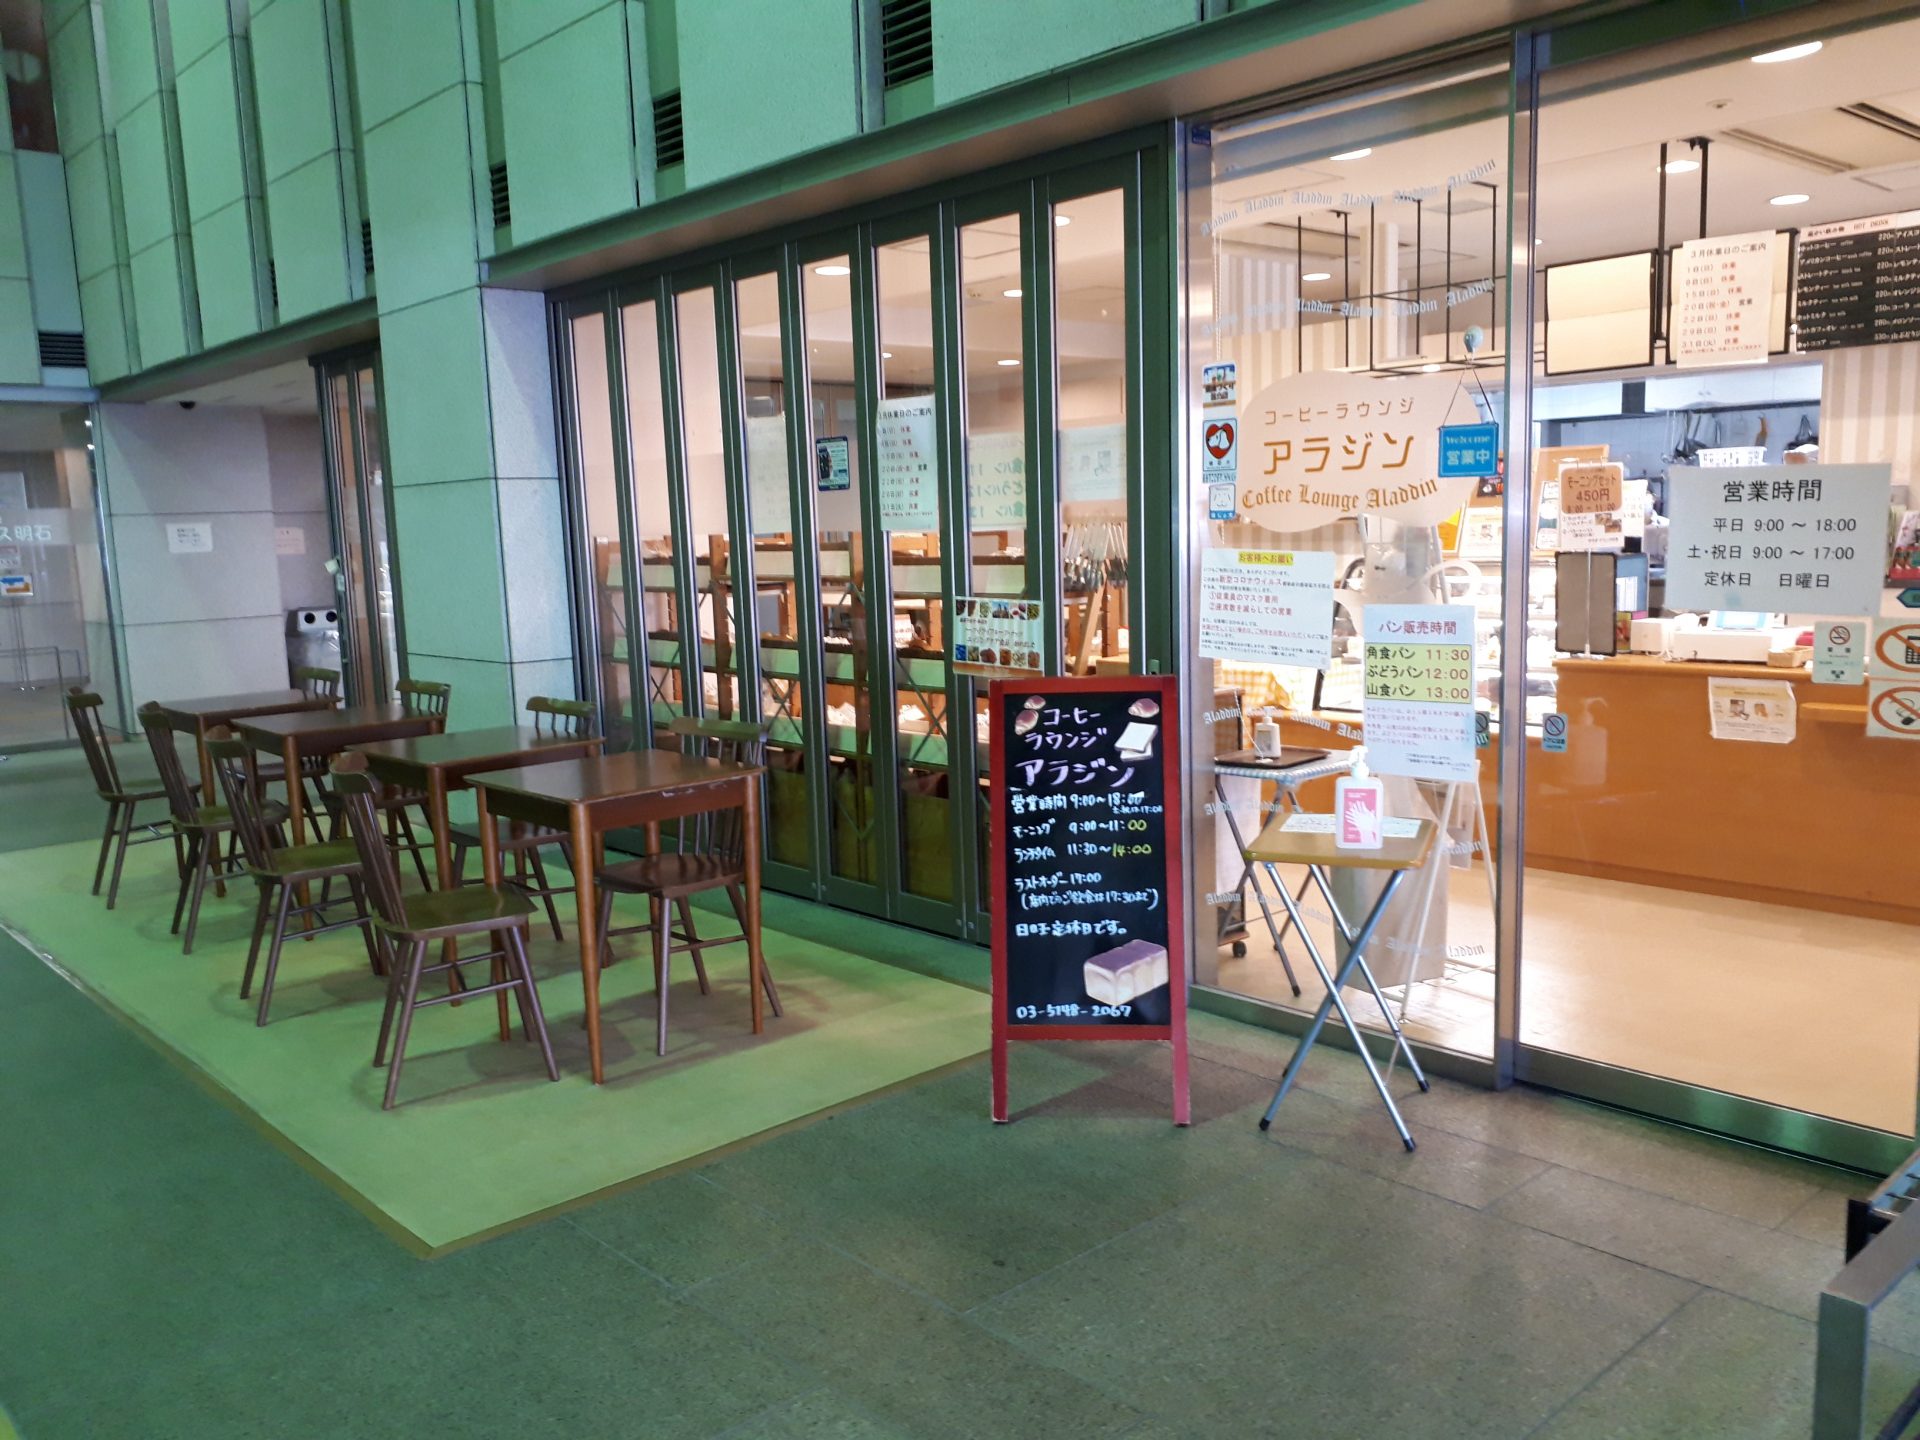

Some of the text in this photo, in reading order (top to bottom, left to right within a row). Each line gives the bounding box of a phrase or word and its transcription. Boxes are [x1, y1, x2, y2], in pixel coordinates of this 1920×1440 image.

[1245, 194, 1284, 213] Aladdin
[1292, 191, 1332, 205] Aladdin
[1448, 159, 1496, 188] Aladdin
[1447, 278, 1495, 307] Aladdin
[1265, 397, 1415, 425] コーヒーラウンジ
[1446, 435, 1490, 444] Welcome
[1263, 432, 1414, 475] アラジン
[1446, 449, 1490, 466] 営業中
[1567, 474, 1617, 489] モーニングセット
[1242, 478, 1437, 512] Coffee Lounge Aladdin
[1576, 488, 1610, 501] 450円
[1724, 480, 1822, 503] 営業時間
[1713, 518, 1744, 532] 平日
[1754, 518, 1784, 532] 9:00
[1816, 518, 1857, 532] 18:00
[1239, 552, 1293, 564] お客様へお願い
[1687, 544, 1742, 560] 土・祝日
[1753, 546, 1783, 559] 9:00
[1813, 546, 1855, 560] 17:00
[1704, 571, 1830, 589] 定休日 日曜日
[1379, 620, 1457, 635] パン販売時間
[1367, 646, 1469, 661] 角食パン 11:30
[1367, 665, 1468, 680] ぶどうパン 12:00
[1367, 683, 1469, 699] 山食パン 13:00
[1043, 707, 1101, 725] コーヒー
[1203, 707, 1242, 725] Aladdin
[1290, 713, 1331, 732] Aladdin
[1336, 722, 1363, 741] Alad
[1025, 728, 1107, 750] ラウンジ
[1015, 758, 1135, 787] アラジン
[1011, 793, 1067, 814] 営業時間
[1013, 818, 1056, 839] モーニング
[1014, 846, 1056, 863] ランチタイム
[1014, 871, 1101, 892] ラストオーダー 17:00
